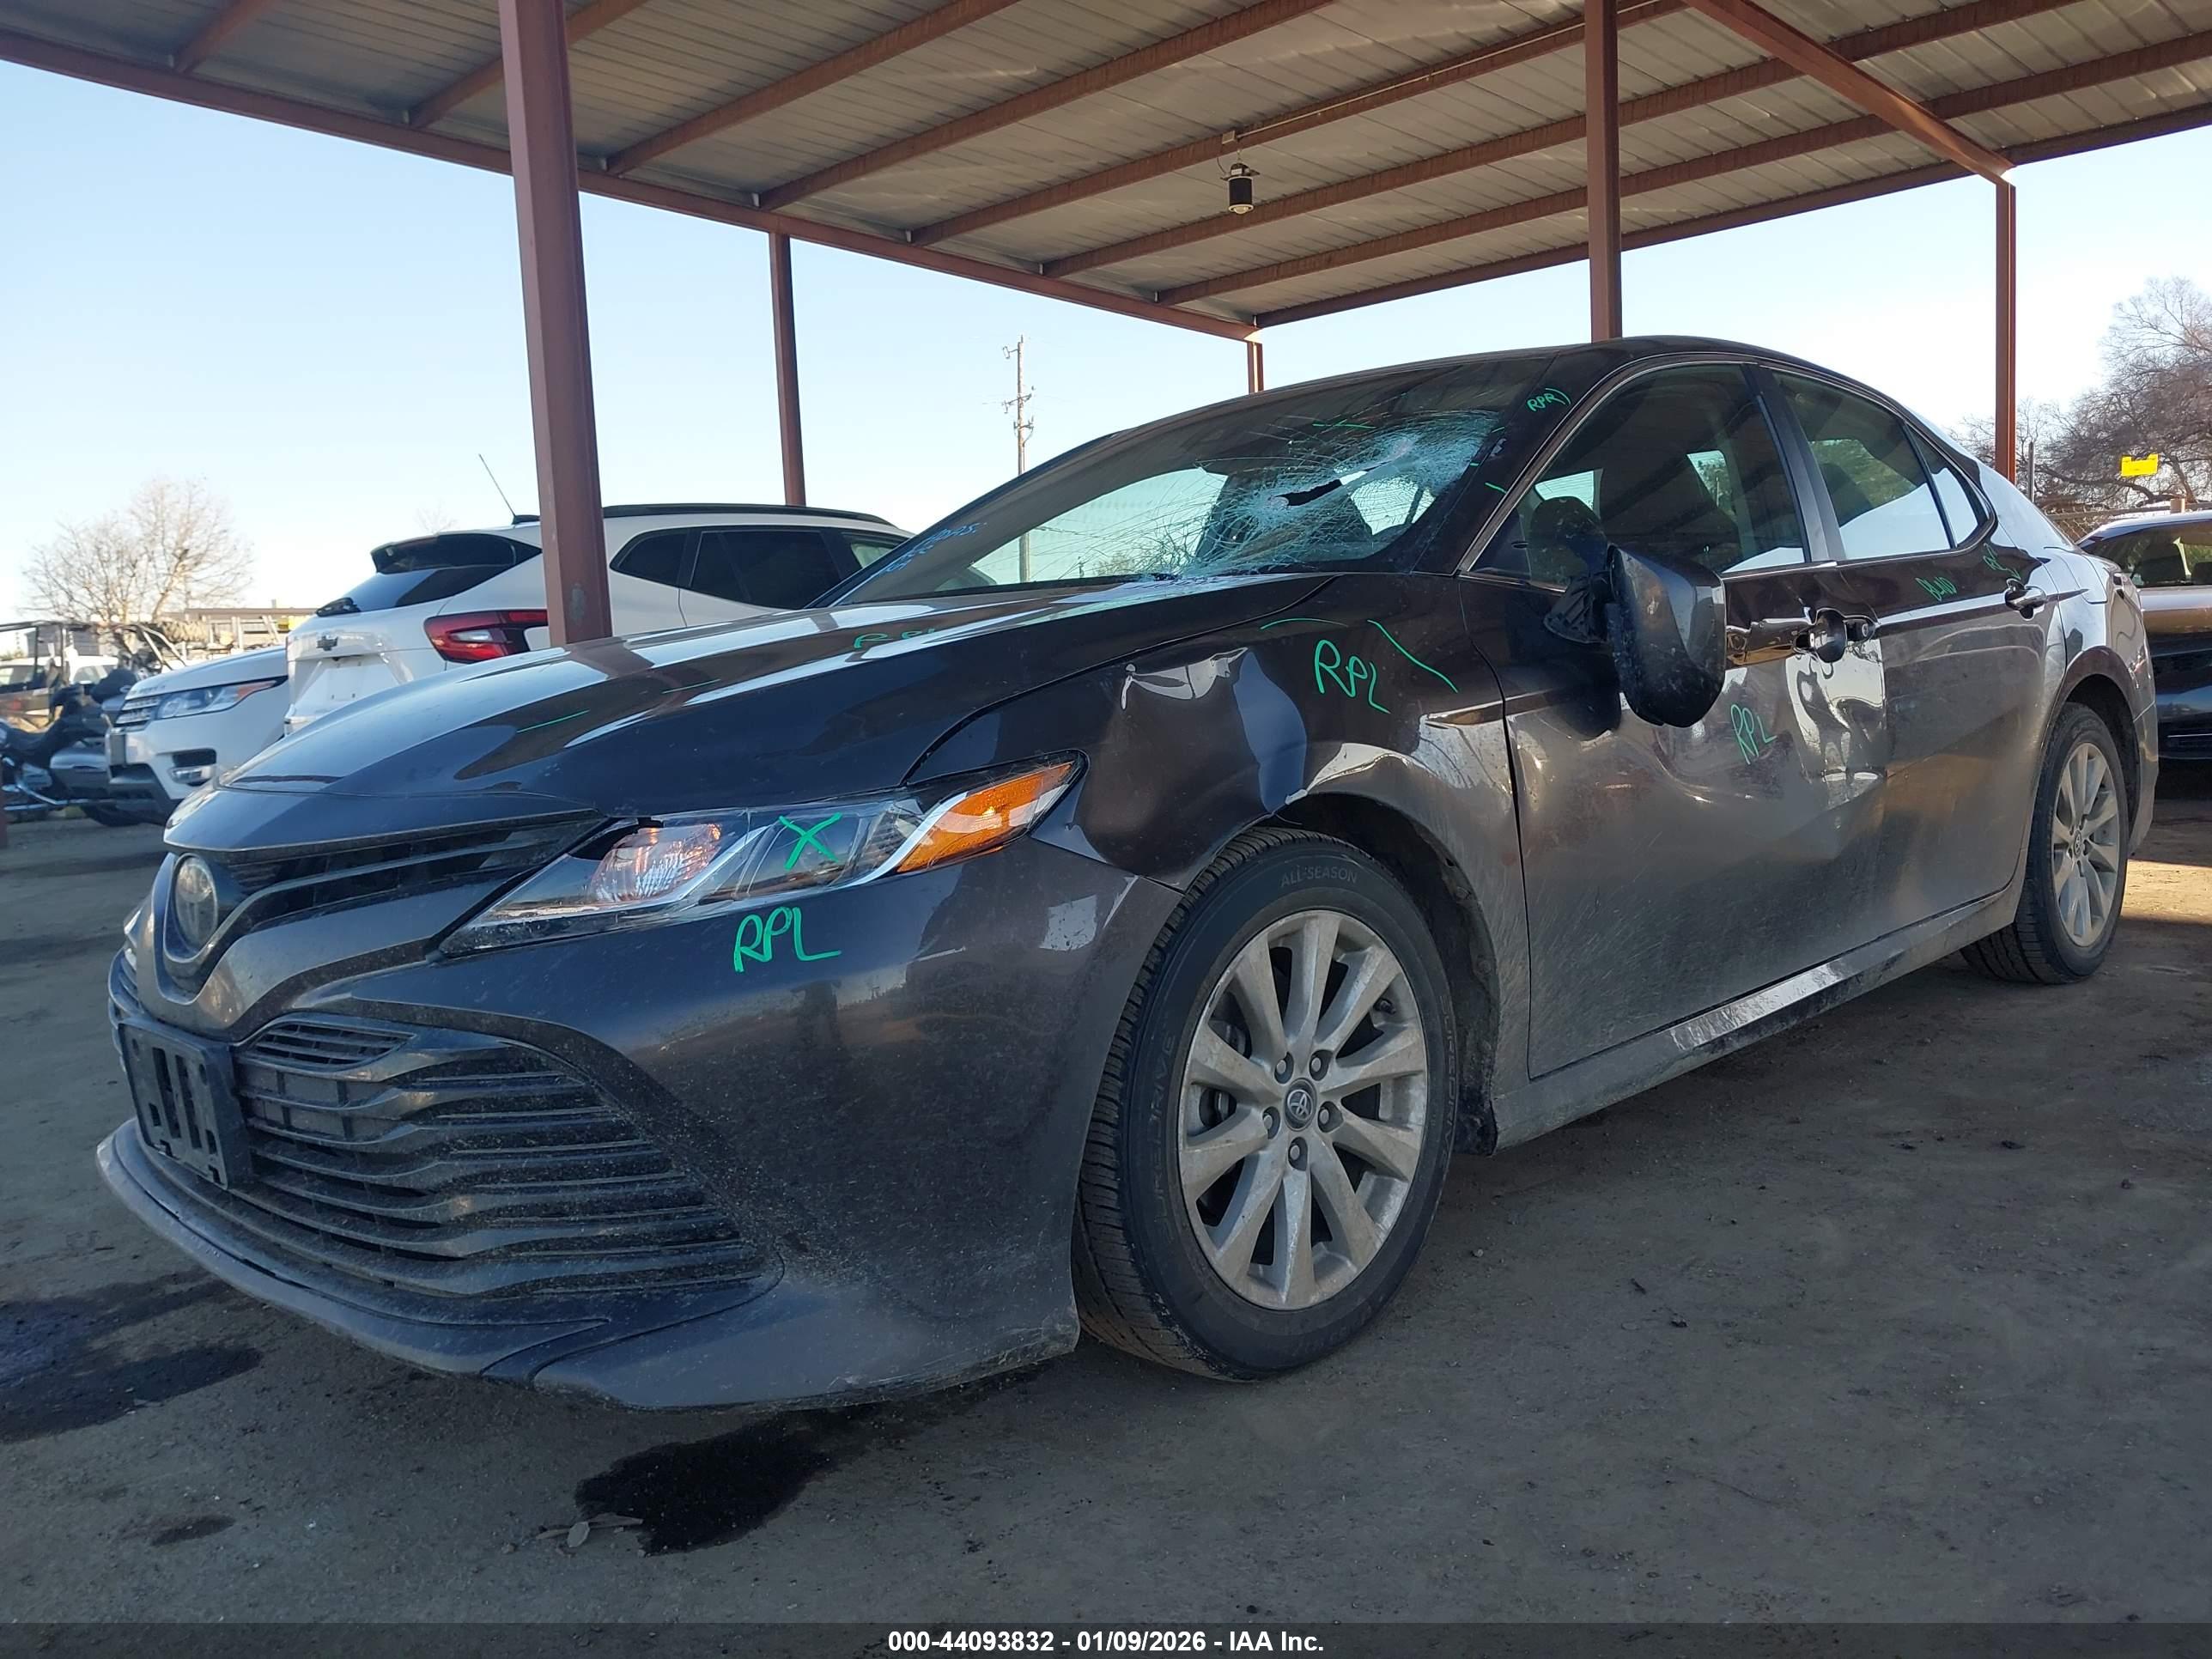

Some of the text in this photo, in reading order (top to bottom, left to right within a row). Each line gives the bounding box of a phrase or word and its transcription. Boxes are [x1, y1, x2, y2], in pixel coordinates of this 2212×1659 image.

[1314, 639, 1391, 714] RPL
[1730, 703, 1778, 765] RPL
[733, 906, 842, 972] RPL
